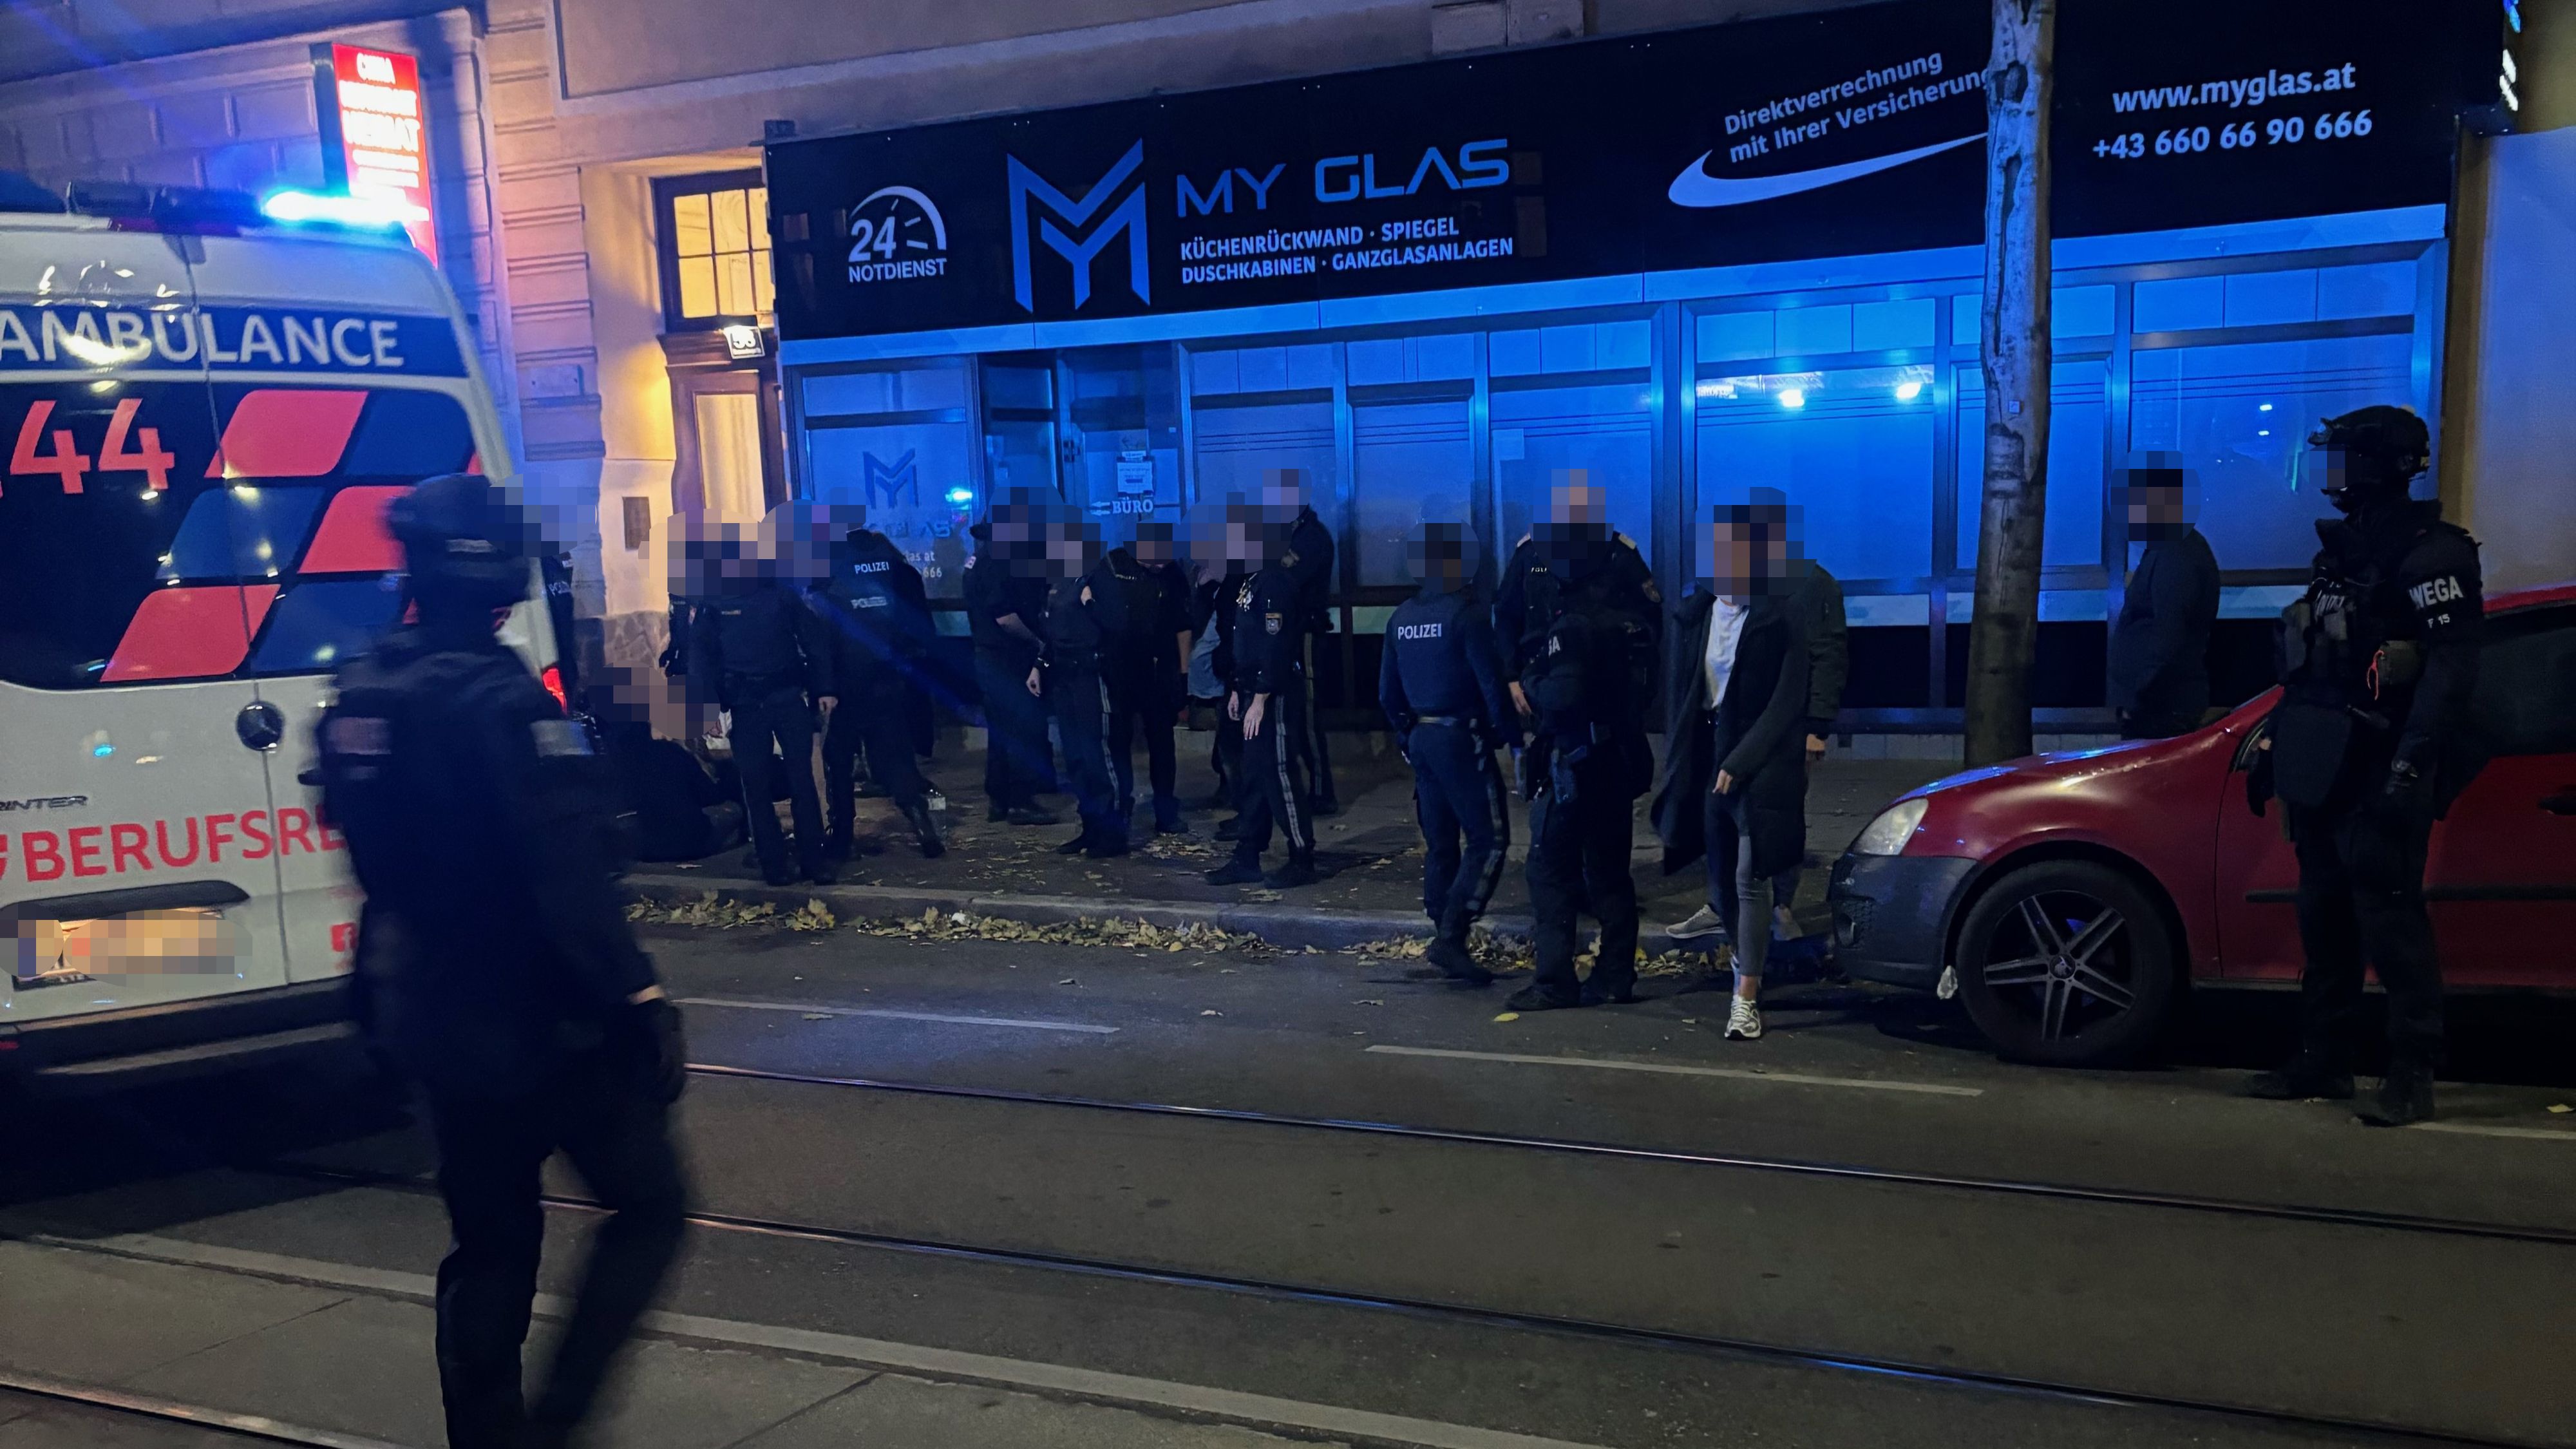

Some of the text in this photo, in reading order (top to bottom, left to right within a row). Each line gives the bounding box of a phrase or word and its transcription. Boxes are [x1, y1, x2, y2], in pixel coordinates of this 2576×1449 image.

[1725, 53, 1942, 134] Direktverrechnung
[2113, 61, 2356, 113] www.myglas.at
[1728, 135, 1770, 164] mit
[1774, 117, 1830, 150] Ihrer
[2092, 109, 2372, 159] +43 660 66 90 666
[1177, 138, 1509, 218] MY GLAS
[848, 216, 896, 262] 24
[1180, 216, 1459, 260] KÜCHENRÜCKWAND SPIEGEL
[1182, 237, 1513, 284] DUSCHKABINEN GANZGLASANLAGEN
[849, 258, 947, 283] NOTDIENST
[0, 310, 403, 366] AMBULANCE
[0, 398, 175, 496] 44
[1112, 496, 1154, 515] BÜRO
[854, 561, 890, 574] POLIZEI
[2409, 576, 2463, 609] WEGA
[1397, 623, 1443, 641] POLIZEI
